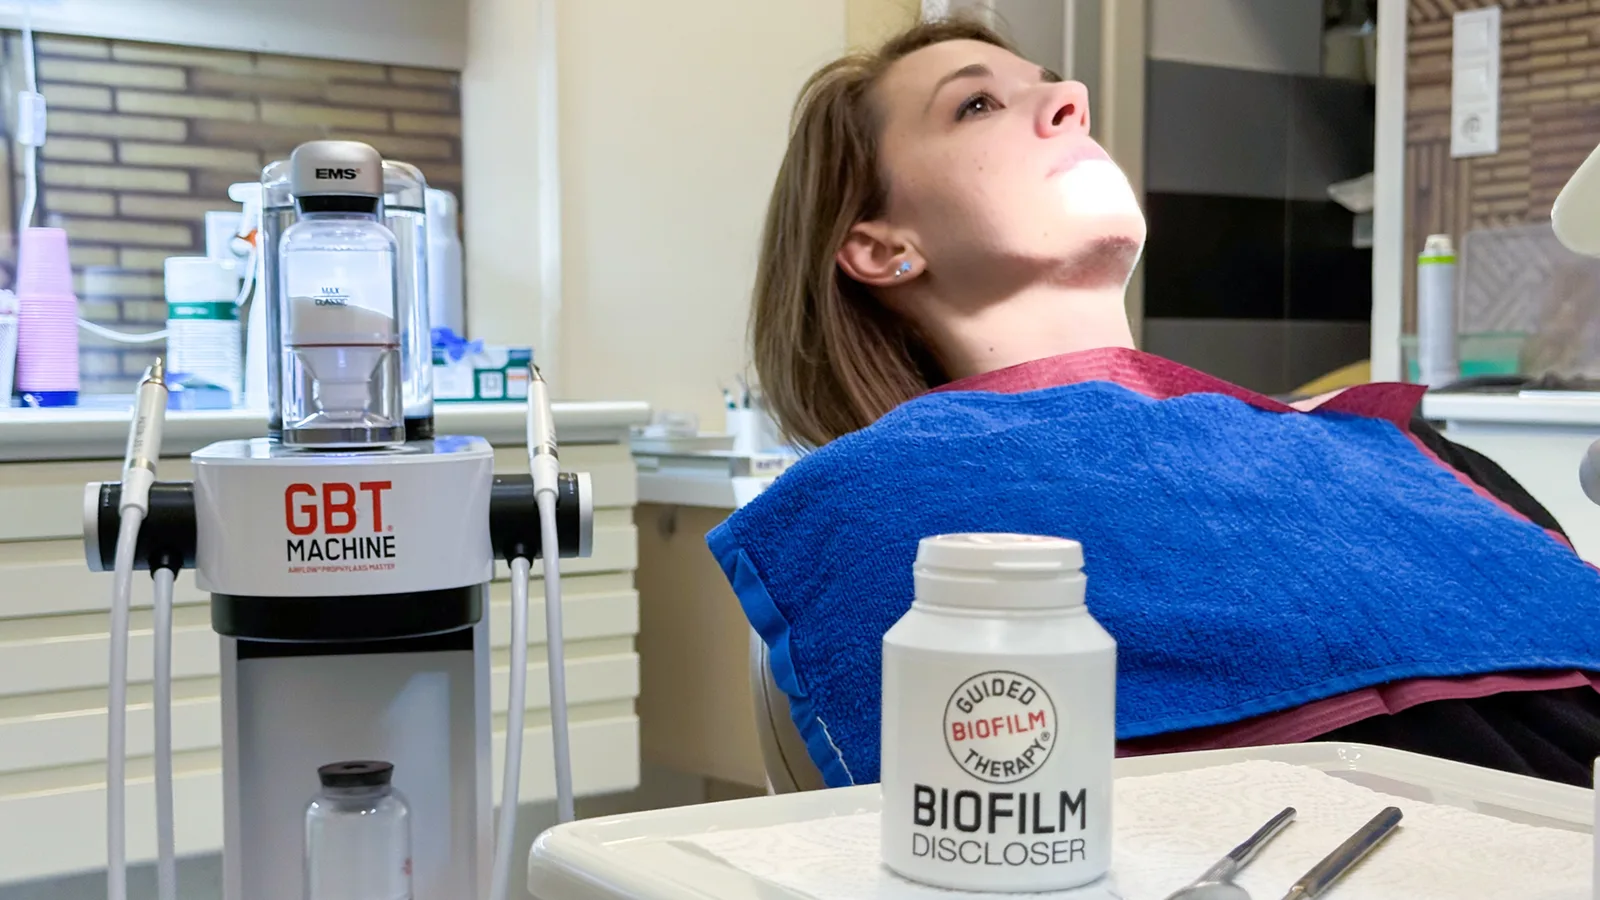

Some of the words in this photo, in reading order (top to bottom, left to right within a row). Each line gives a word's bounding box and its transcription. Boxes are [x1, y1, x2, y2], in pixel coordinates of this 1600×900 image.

[287, 536, 396, 561] MACHINE
[322, 564, 368, 573] PROPHYLAXIS
[369, 563, 396, 571] MASTER
[956, 678, 1036, 714] GUIDED
[951, 709, 1046, 742] BIOFILM
[913, 783, 1087, 835] BIOFILM
[912, 832, 1086, 867] DISCLOSER
